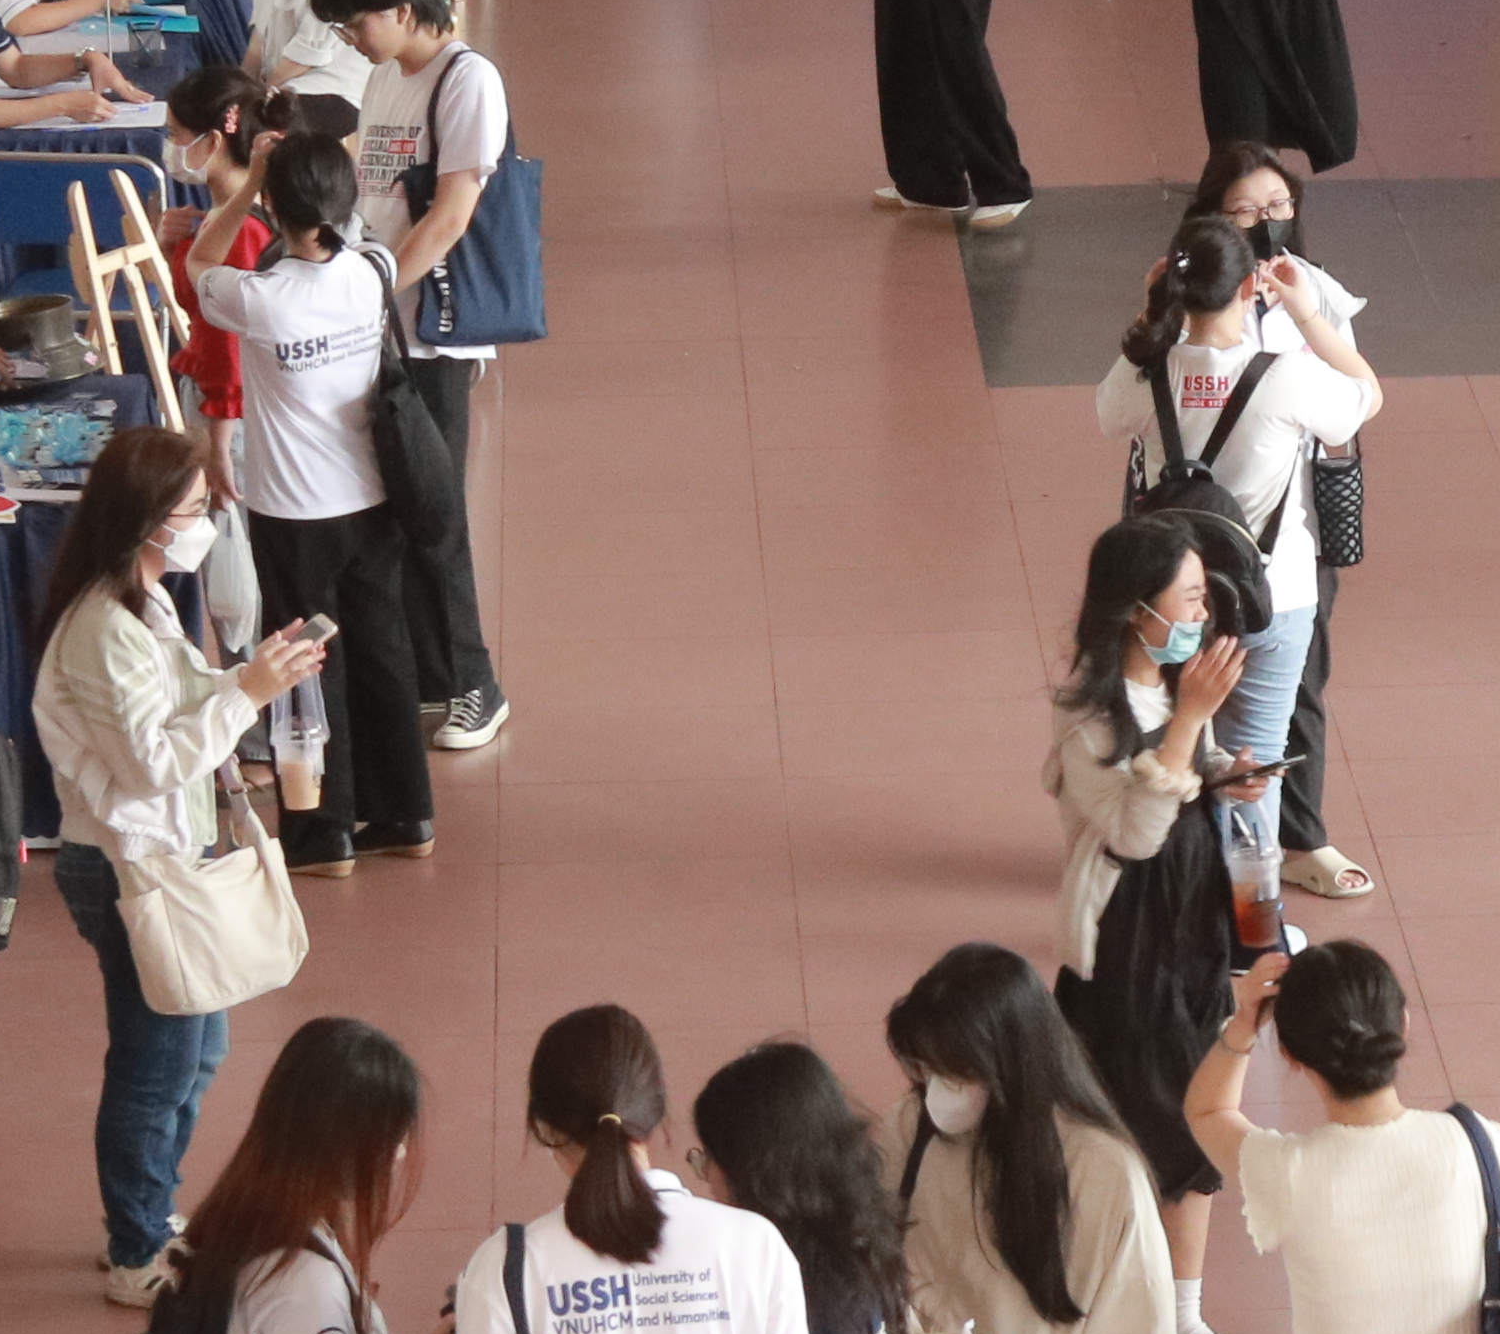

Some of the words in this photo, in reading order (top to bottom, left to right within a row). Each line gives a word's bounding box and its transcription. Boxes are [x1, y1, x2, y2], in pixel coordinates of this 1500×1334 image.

[275, 334, 329, 361] USSH
[276, 354, 331, 373] VNUHCM
[1184, 375, 1230, 391] USSH
[633, 1270, 695, 1286] University
[699, 1268, 711, 1281] of
[547, 1273, 631, 1316] USSH
[635, 1292, 668, 1305] Social
[673, 1290, 719, 1303] Sciences
[637, 1314, 660, 1327] and
[664, 1309, 731, 1326] Humanities
